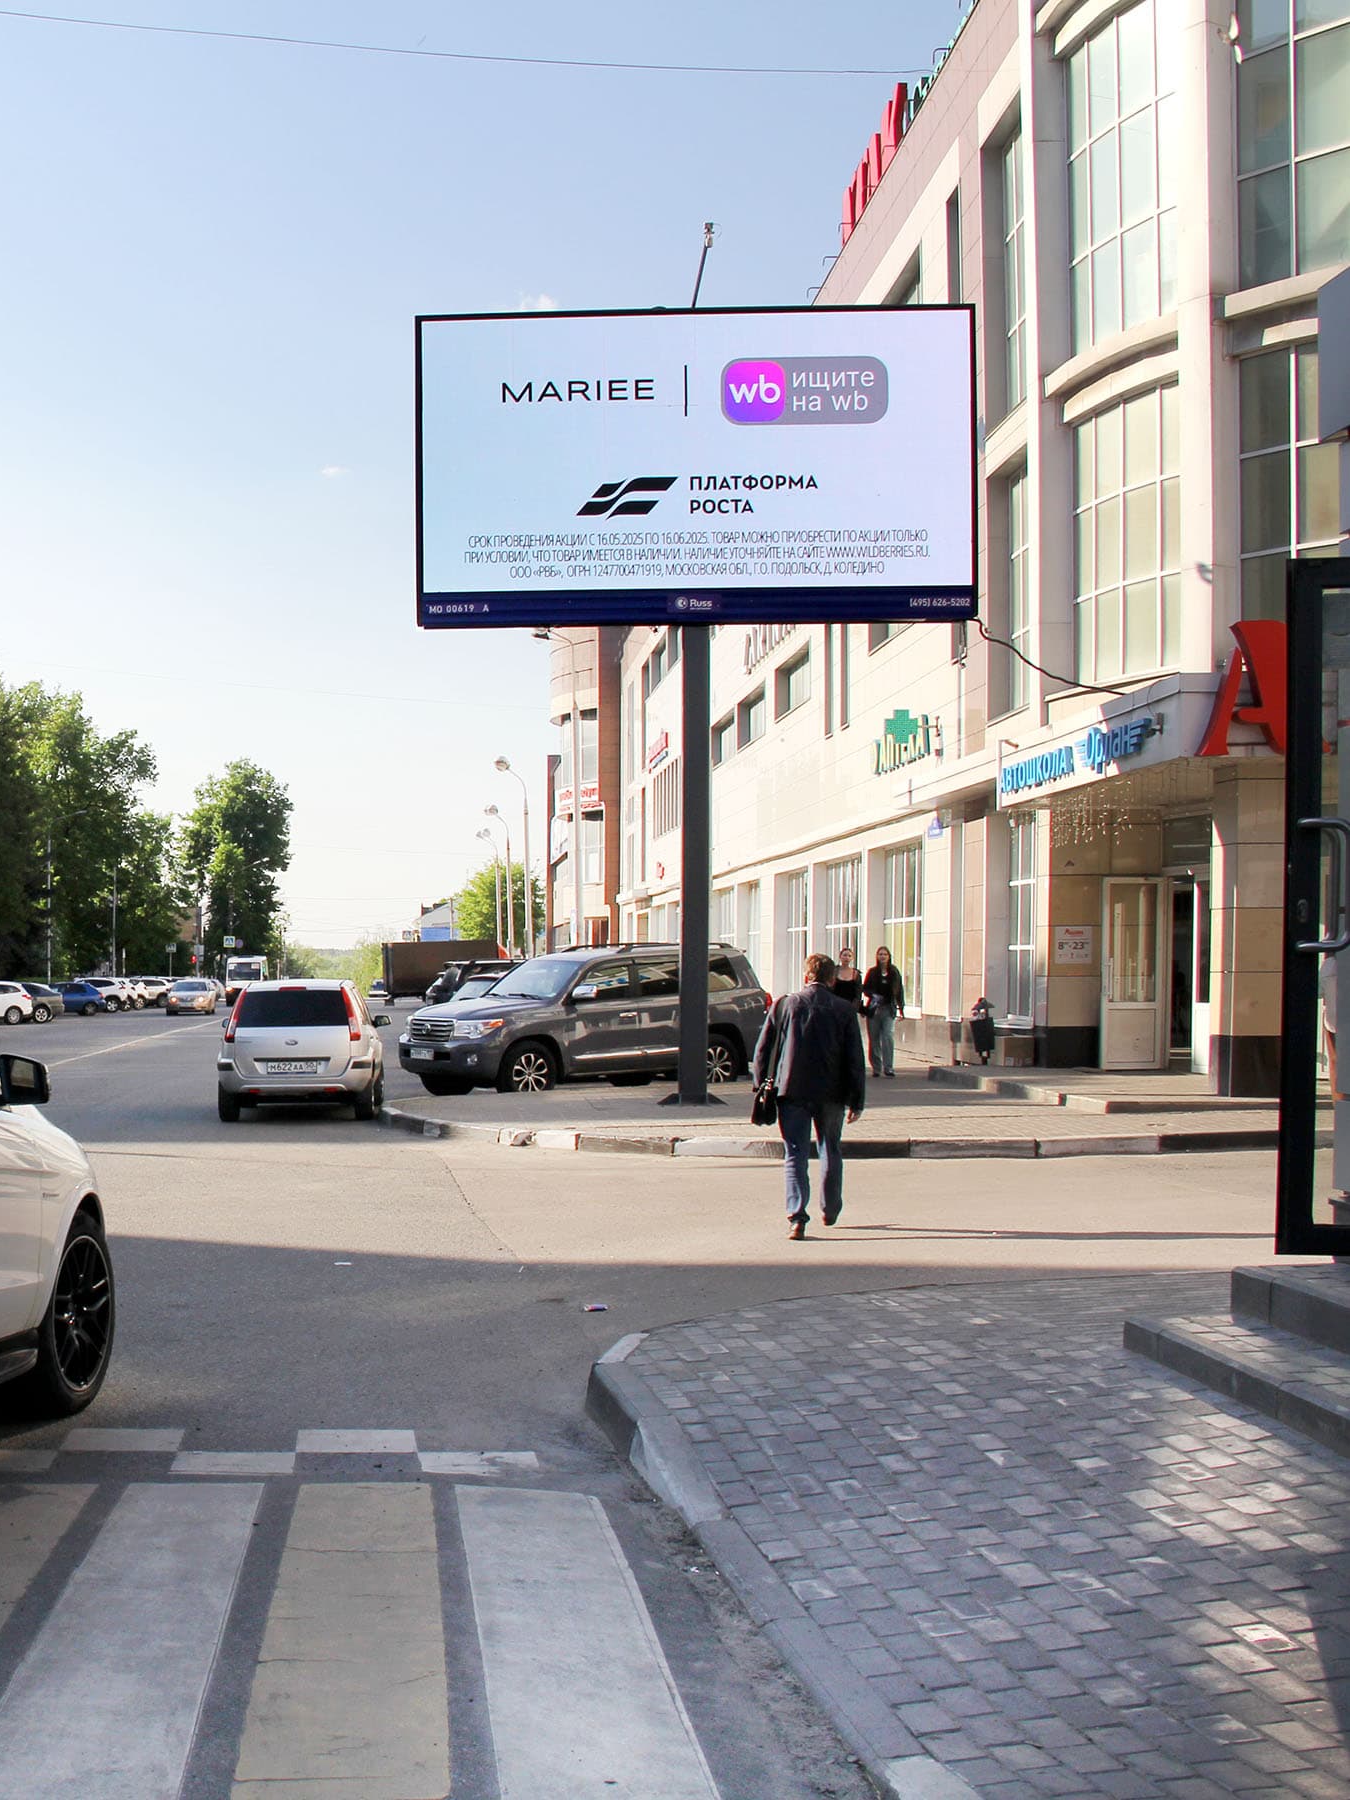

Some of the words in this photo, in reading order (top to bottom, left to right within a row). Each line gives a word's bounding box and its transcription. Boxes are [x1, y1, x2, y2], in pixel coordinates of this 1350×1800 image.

[728, 374, 781, 404] wb
[792, 369, 875, 391] ищите
[501, 379, 654, 403] MARIEE
[792, 394, 822, 411] на
[831, 391, 869, 411] wb
[690, 475, 818, 491] ПЛАТФОРМА
[690, 499, 754, 514] РОСТА
[468, 535, 492, 548] СРОК
[494, 534, 554, 549] ПРОВЕДЕНИЯ
[555, 534, 587, 548] АКЦИИ
[589, 533, 595, 546] С
[597, 533, 644, 546] 16.05.2025
[645, 533, 659, 545] ПО
[661, 532, 709, 545] 16.06.2025.
[712, 531, 740, 544] ТОВАР
[742, 531, 780, 543] МОЖНО
[782, 530, 841, 543] ПРИОБРЕСТИ
[843, 530, 857, 542] ПО
[857, 530, 890, 544] АКЦИИ
[892, 529, 928, 542] ТОЛЬКО
[464, 551, 483, 563] ПРИ
[484, 550, 531, 563] УСЛОВИИ,
[532, 550, 551, 562] ЧТО
[552, 549, 581, 562] ТОВАР
[583, 549, 624, 561] ИМЕЕТСЯ
[626, 549, 633, 561] В
[634, 548, 682, 560] НАЛИЧИИ.
[684, 547, 728, 560] НАЛИЧИЕ
[729, 545, 781, 560] УТОЧНЯЙТЕ
[783, 547, 795, 558] НА
[797, 544, 825, 559] САЙТЕ
[510, 566, 532, 578] ООО
[567, 565, 590, 577] ОГРН
[665, 563, 727, 576] МОСКОВСКАЯ
[834, 561, 885, 575] КОЛЕДИНО
[446, 604, 474, 613] 00619
[689, 599, 712, 607] Russ
[910, 597, 931, 607] (495)
[1001, 746, 1074, 793] АВТОШКОЛА
